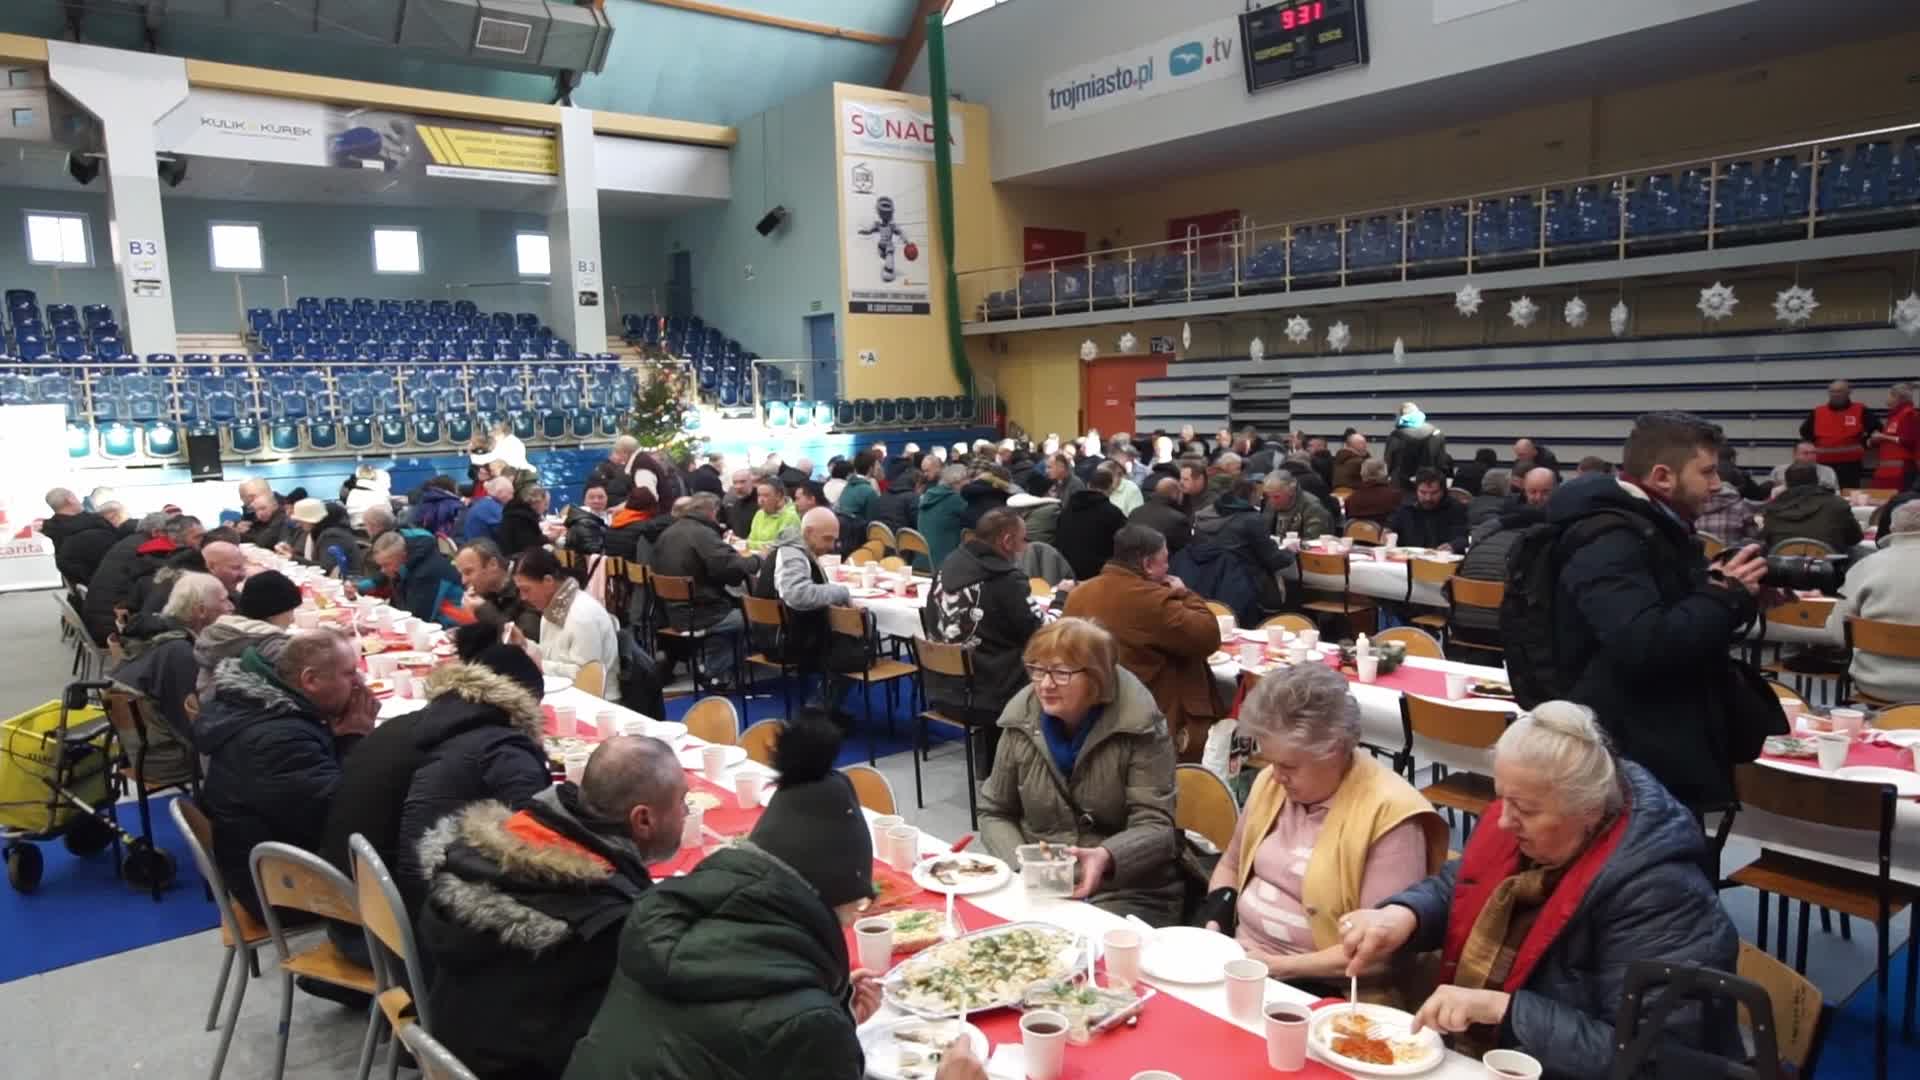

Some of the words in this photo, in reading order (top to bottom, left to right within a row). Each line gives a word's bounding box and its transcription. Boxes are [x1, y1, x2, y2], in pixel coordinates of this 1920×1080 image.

[1049, 56, 1153, 110] trojmiasto.pl
[200, 117, 246, 130] KULIK
[260, 124, 312, 136] KUREK
